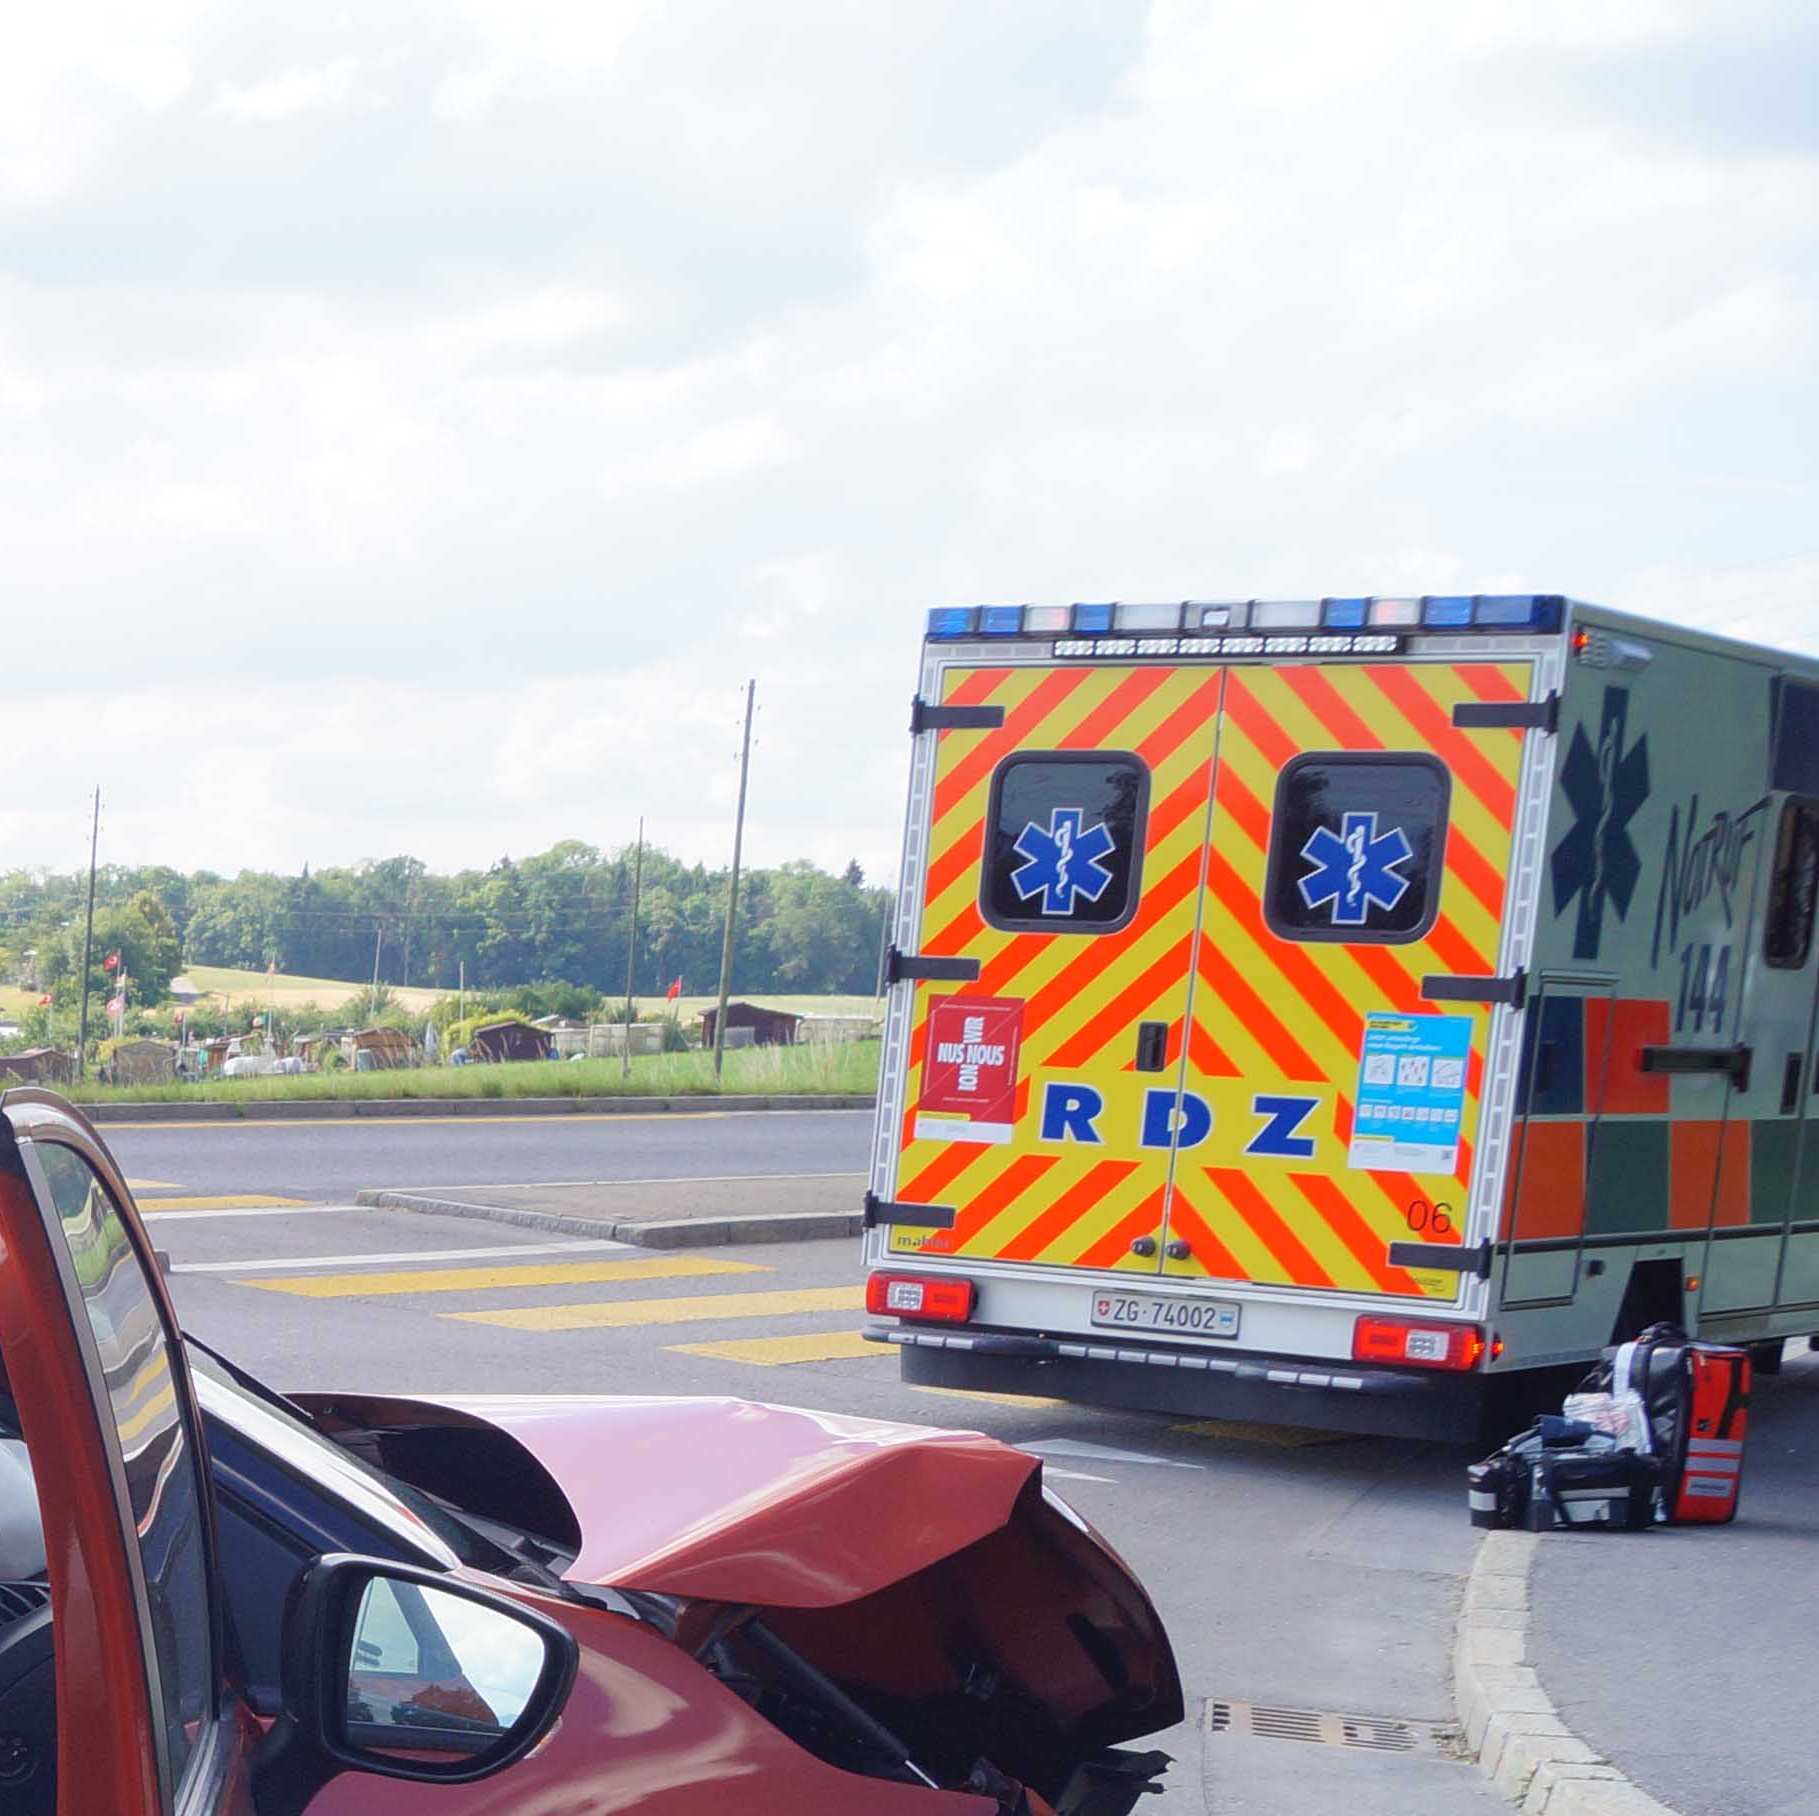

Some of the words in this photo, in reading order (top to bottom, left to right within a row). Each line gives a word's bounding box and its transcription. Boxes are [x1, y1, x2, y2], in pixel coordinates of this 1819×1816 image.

[1674, 943, 1731, 1034] 144
[963, 1016, 985, 1044] WIR
[966, 1044, 1005, 1066] NOUS
[1407, 1200, 1452, 1233] 06
